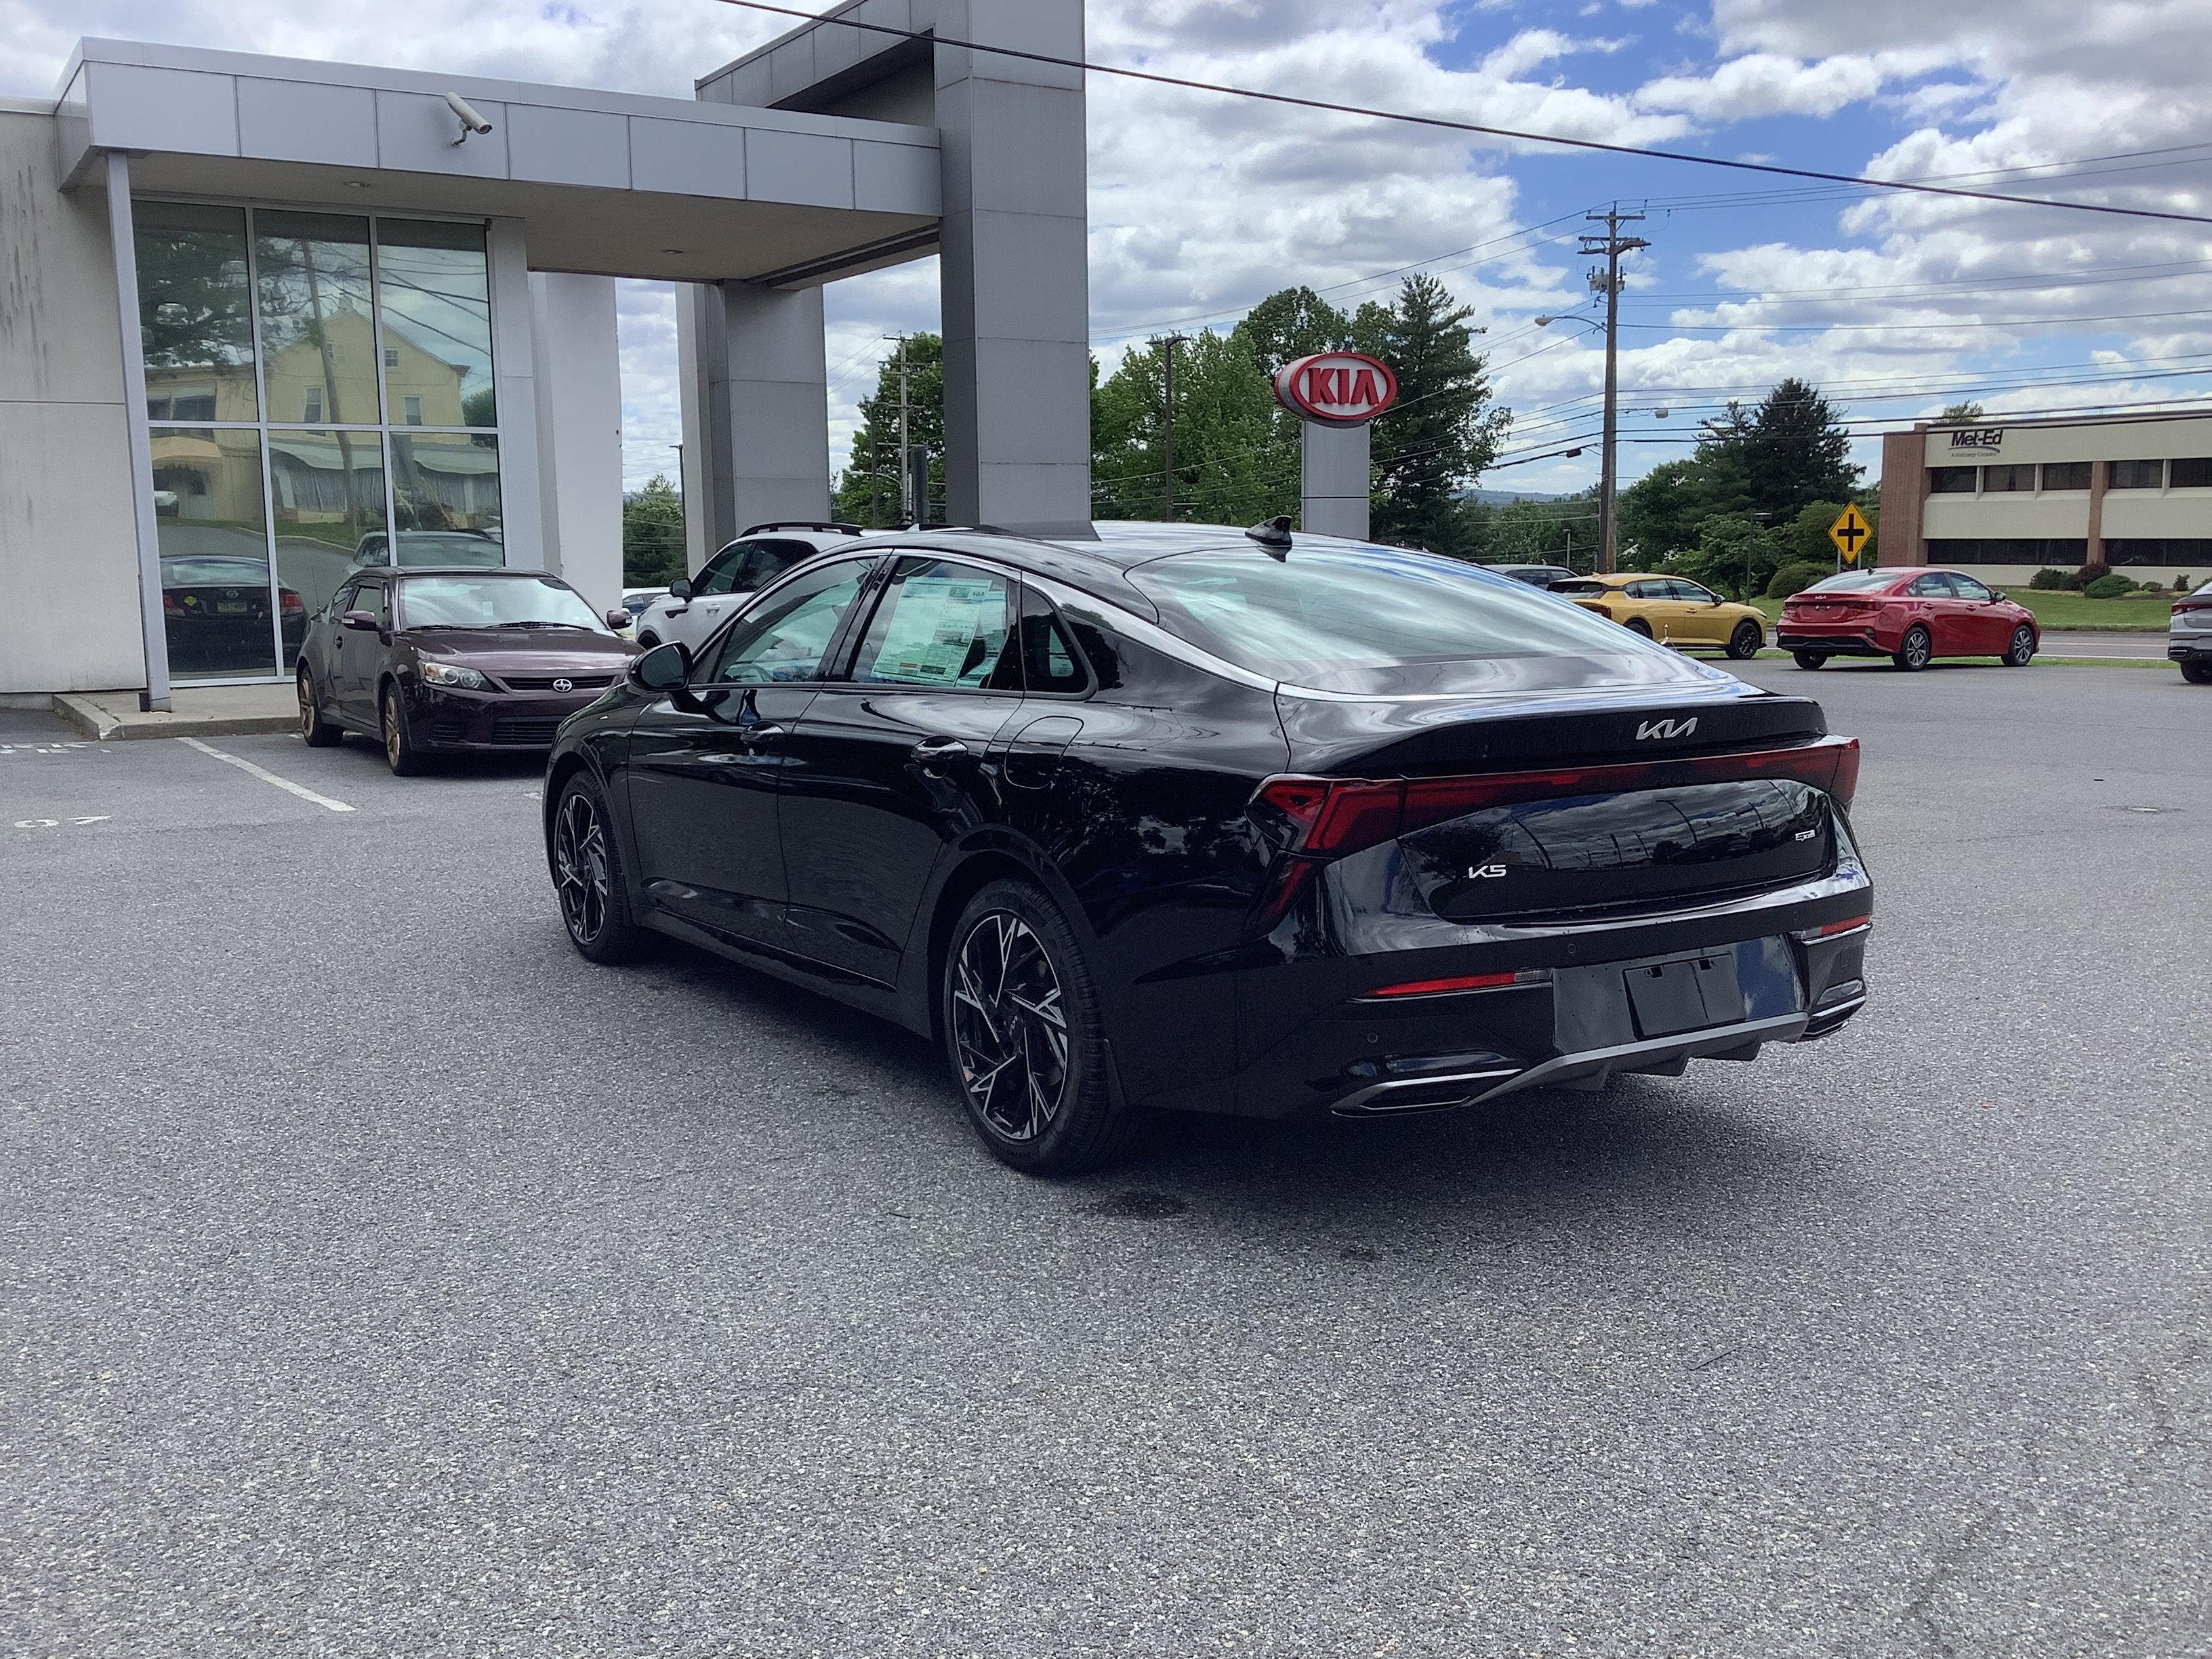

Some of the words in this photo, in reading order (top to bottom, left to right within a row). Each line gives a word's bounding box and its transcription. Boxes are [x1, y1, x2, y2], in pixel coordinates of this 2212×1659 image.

[1307, 368, 1379, 405] KIA
[1951, 428, 2003, 446] Met-Ed
[1636, 718, 1698, 740] KIA
[1468, 864, 1507, 879] K5
